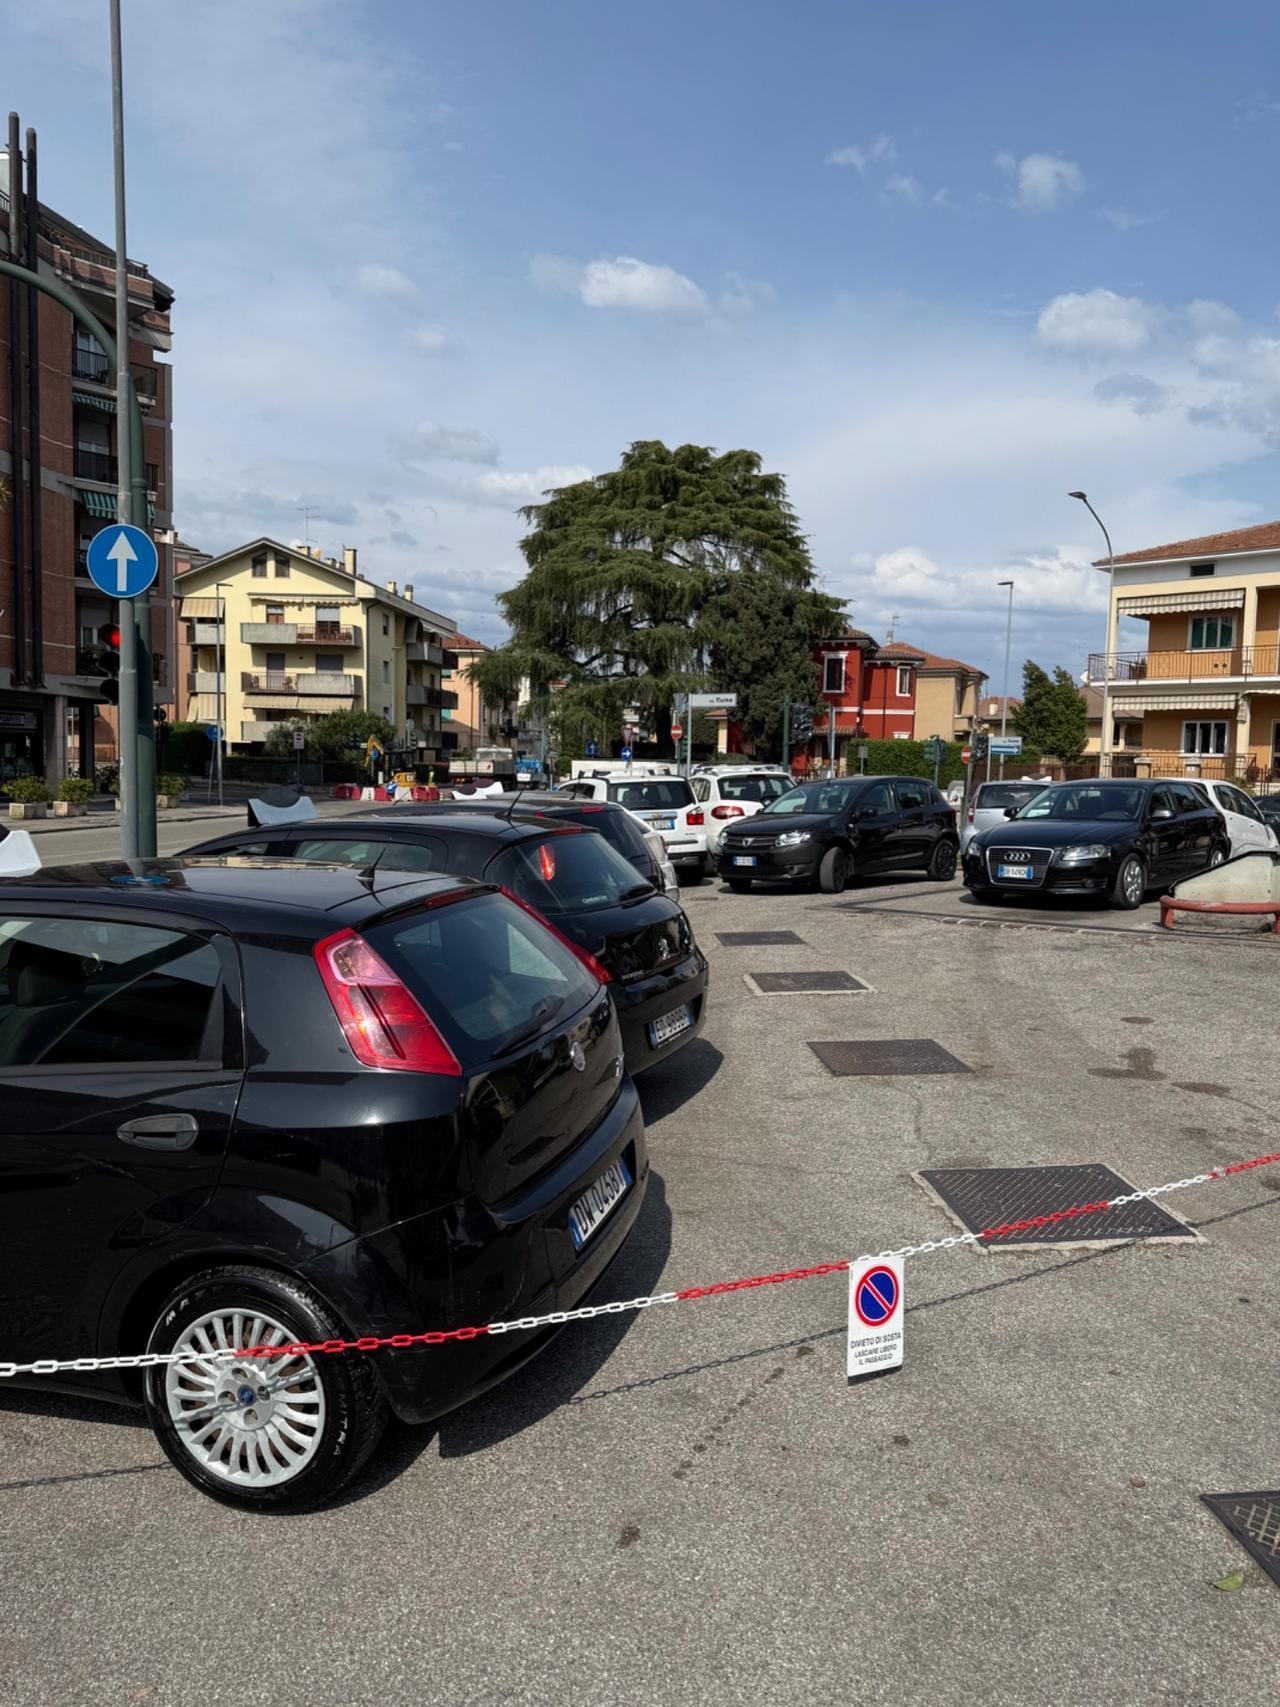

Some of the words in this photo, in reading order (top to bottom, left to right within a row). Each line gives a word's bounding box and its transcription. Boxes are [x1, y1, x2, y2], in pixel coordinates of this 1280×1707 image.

[850, 1337, 874, 1349] DIVIETO
[875, 1336, 882, 1344] DI
[883, 1331, 901, 1342] SOSTA
